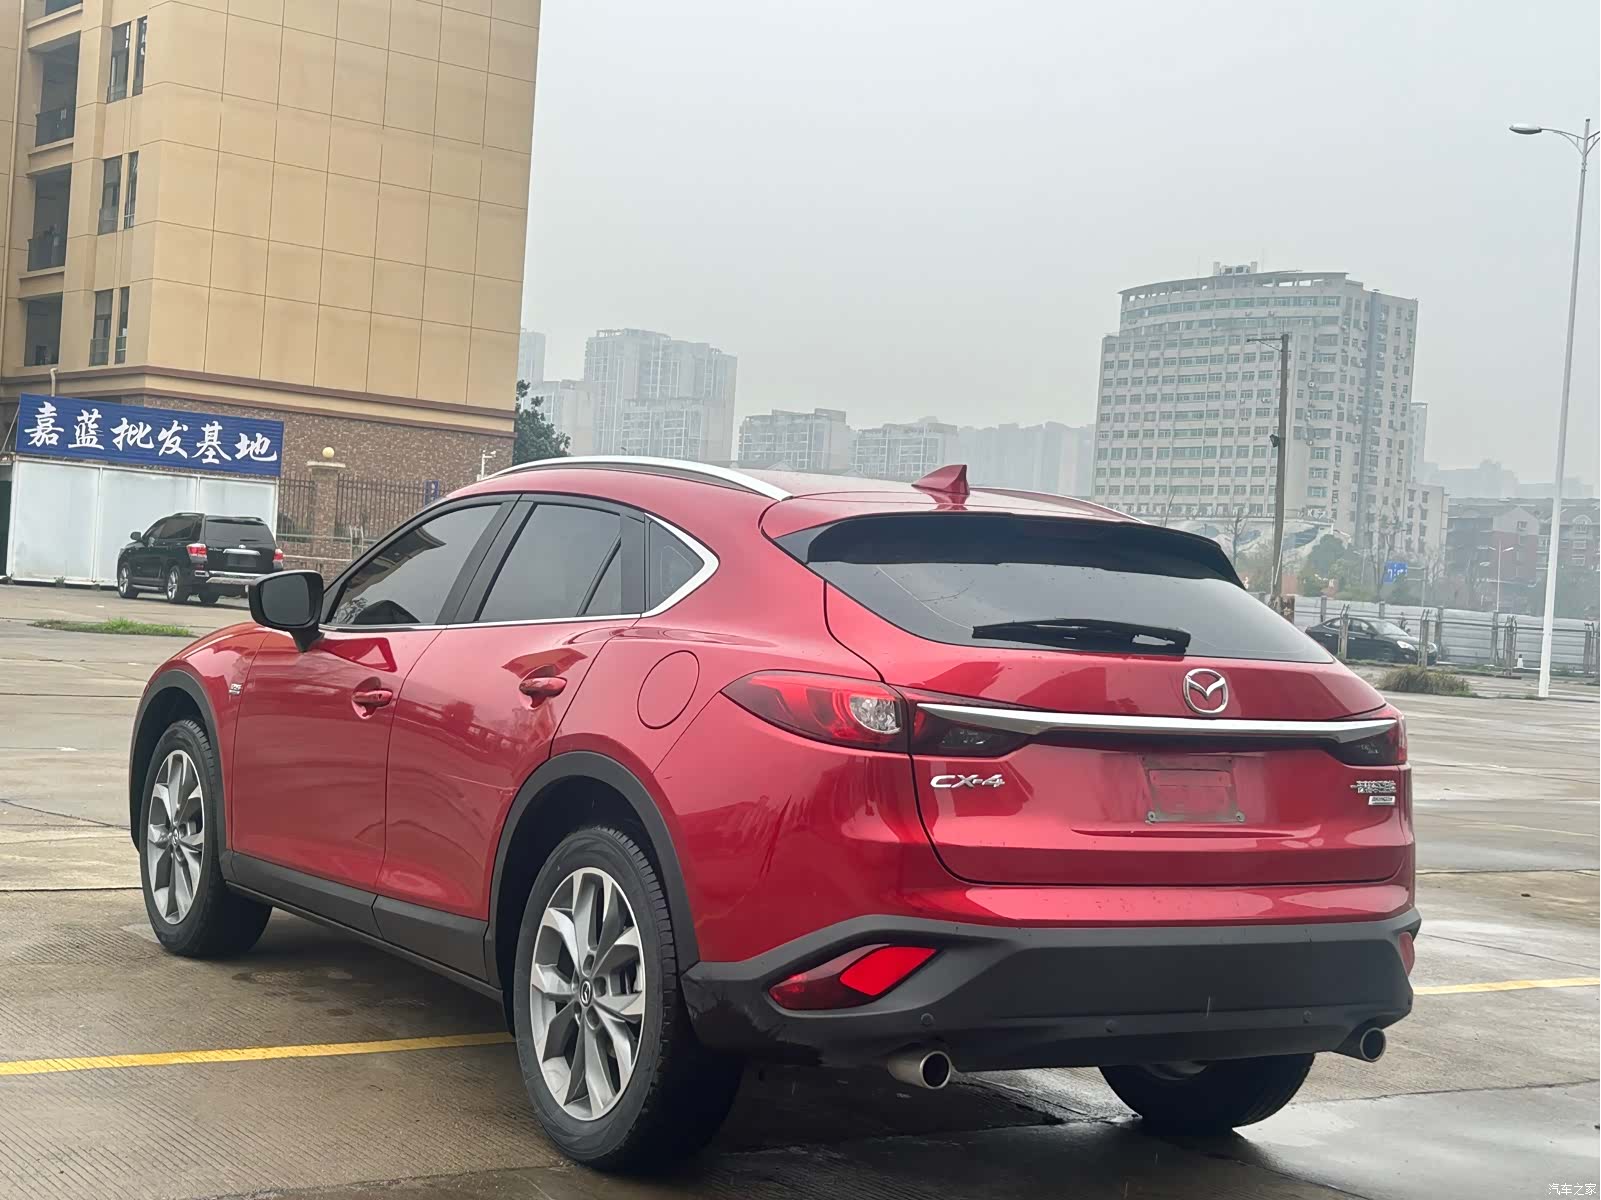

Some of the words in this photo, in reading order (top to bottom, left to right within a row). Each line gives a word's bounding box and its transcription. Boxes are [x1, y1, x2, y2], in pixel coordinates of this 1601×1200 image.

[24, 401, 278, 464] 嘉蓝批发基地
[930, 774, 1005, 788] CX-4
